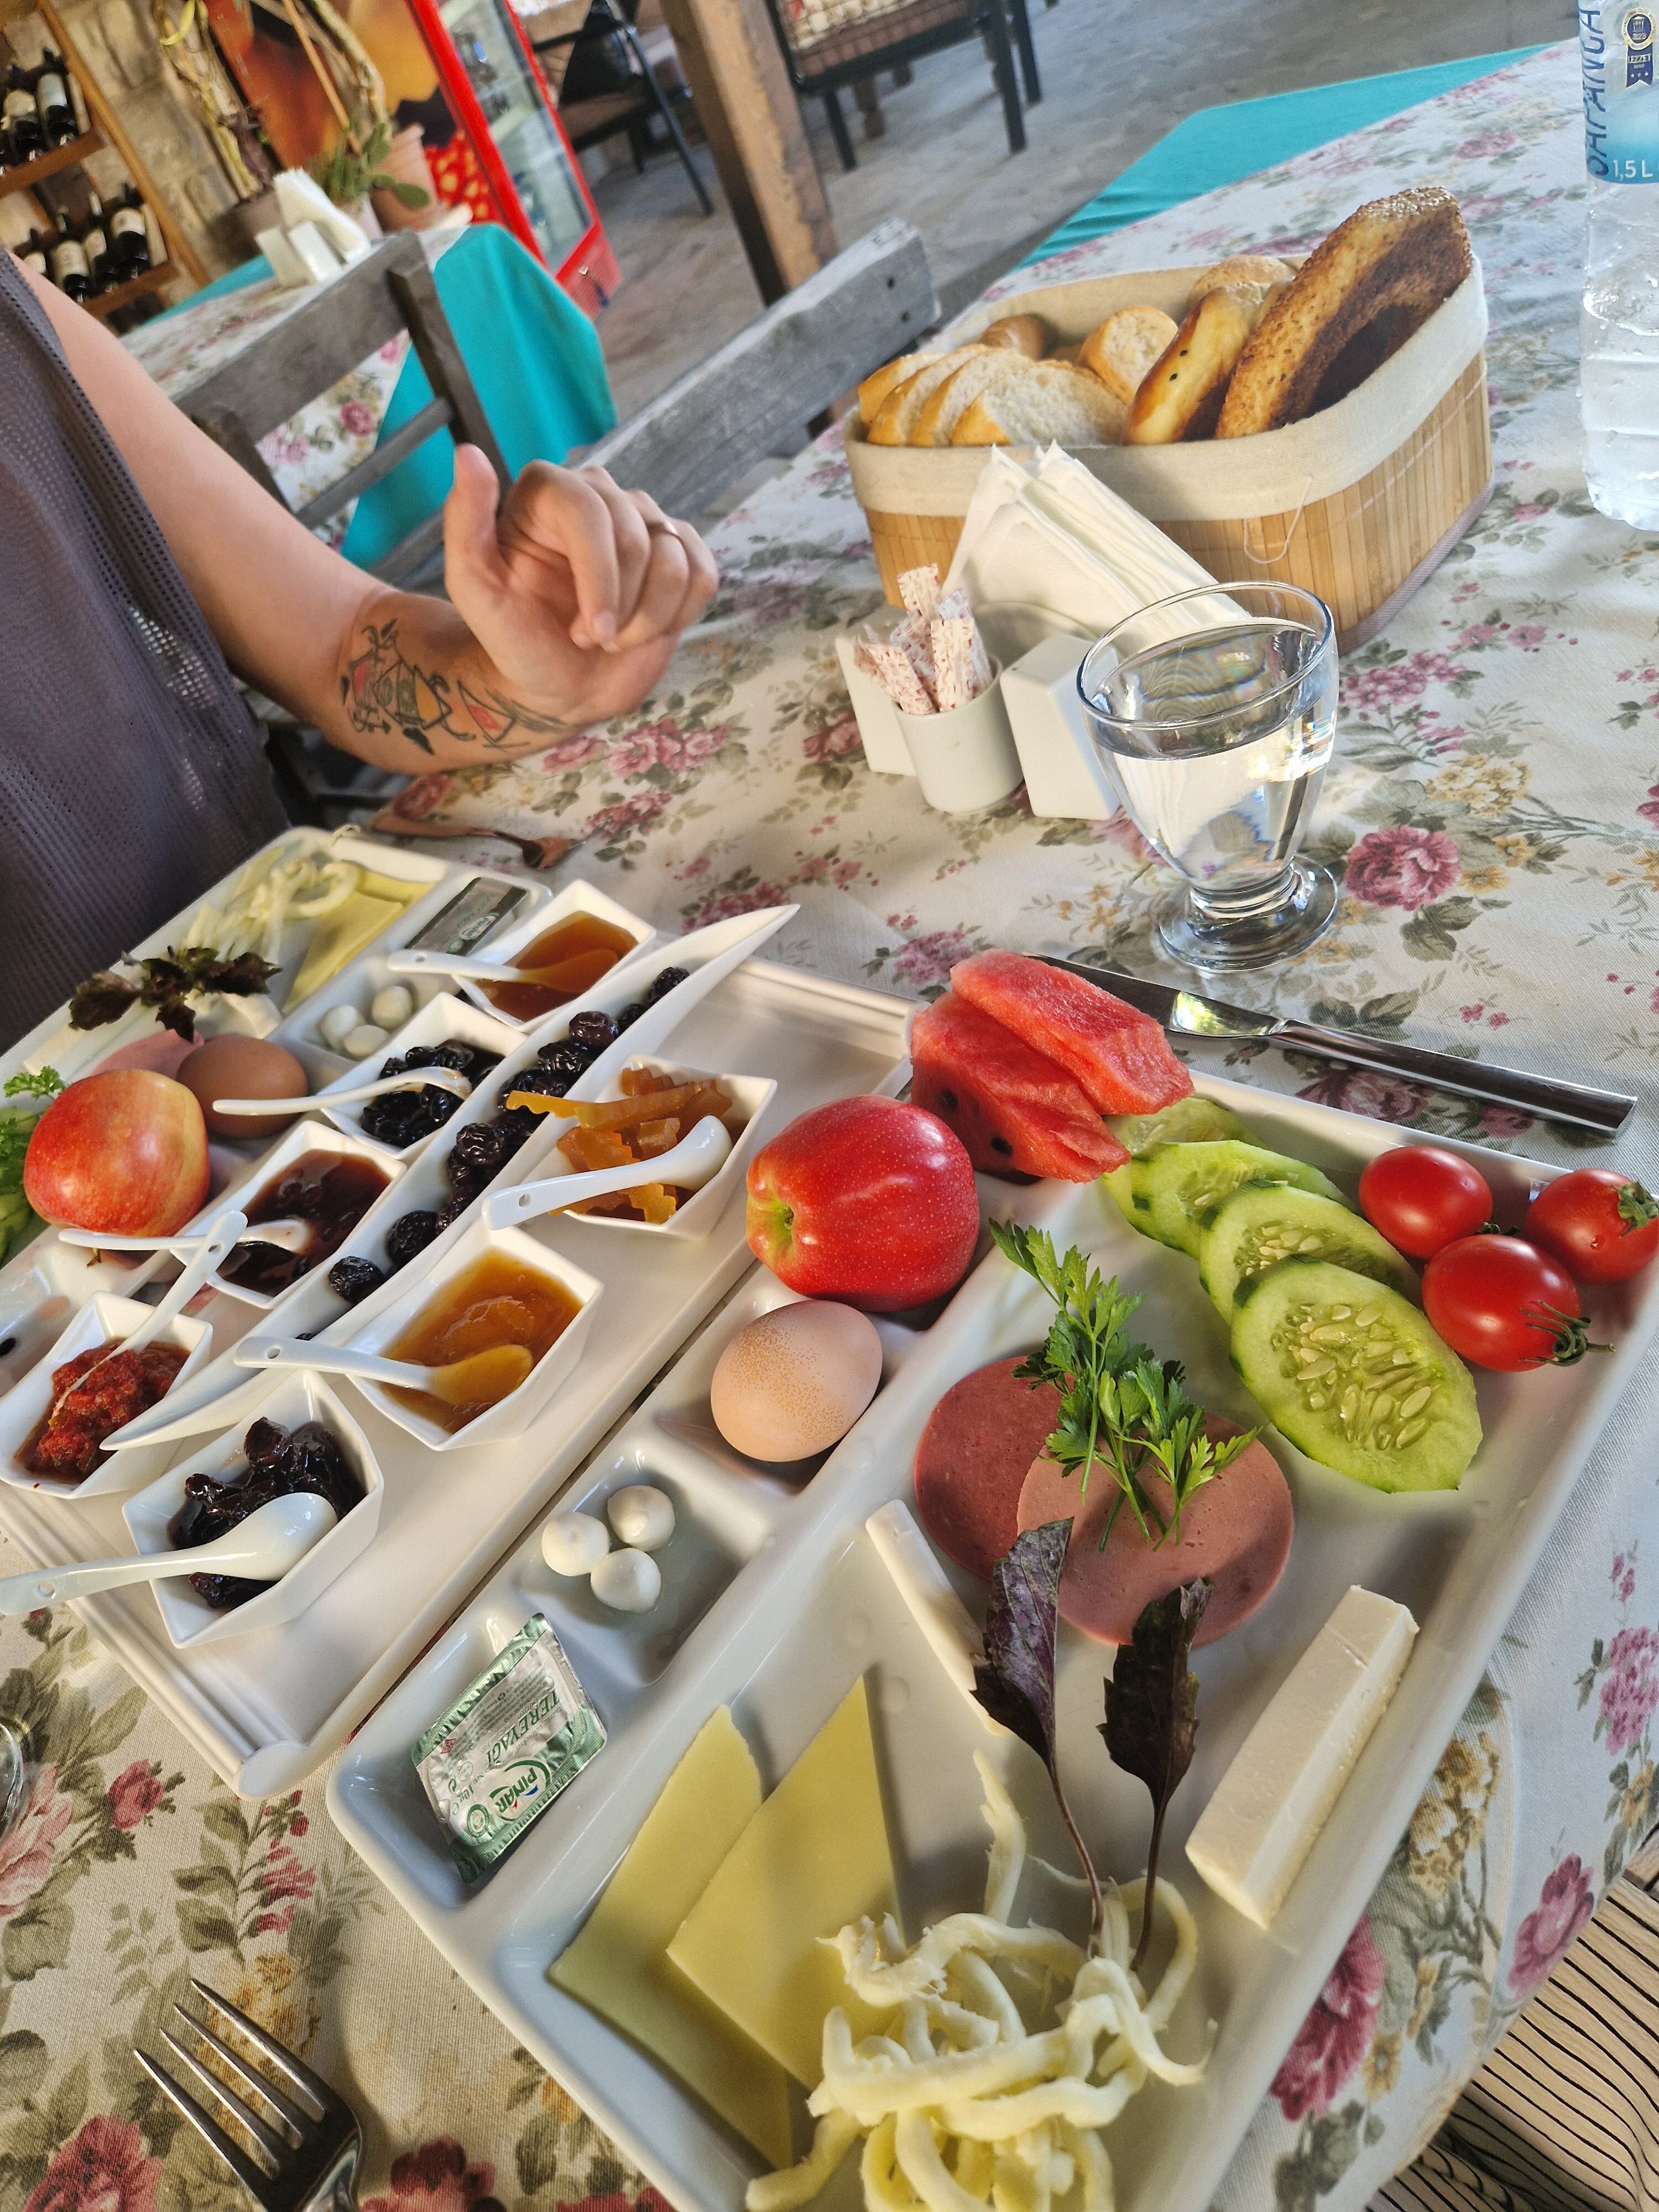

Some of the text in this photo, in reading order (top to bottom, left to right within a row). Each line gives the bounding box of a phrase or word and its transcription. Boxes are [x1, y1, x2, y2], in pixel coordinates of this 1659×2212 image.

[1613, 159, 1653, 181] 1,5 L
[494, 1767, 538, 1813] PINAR
